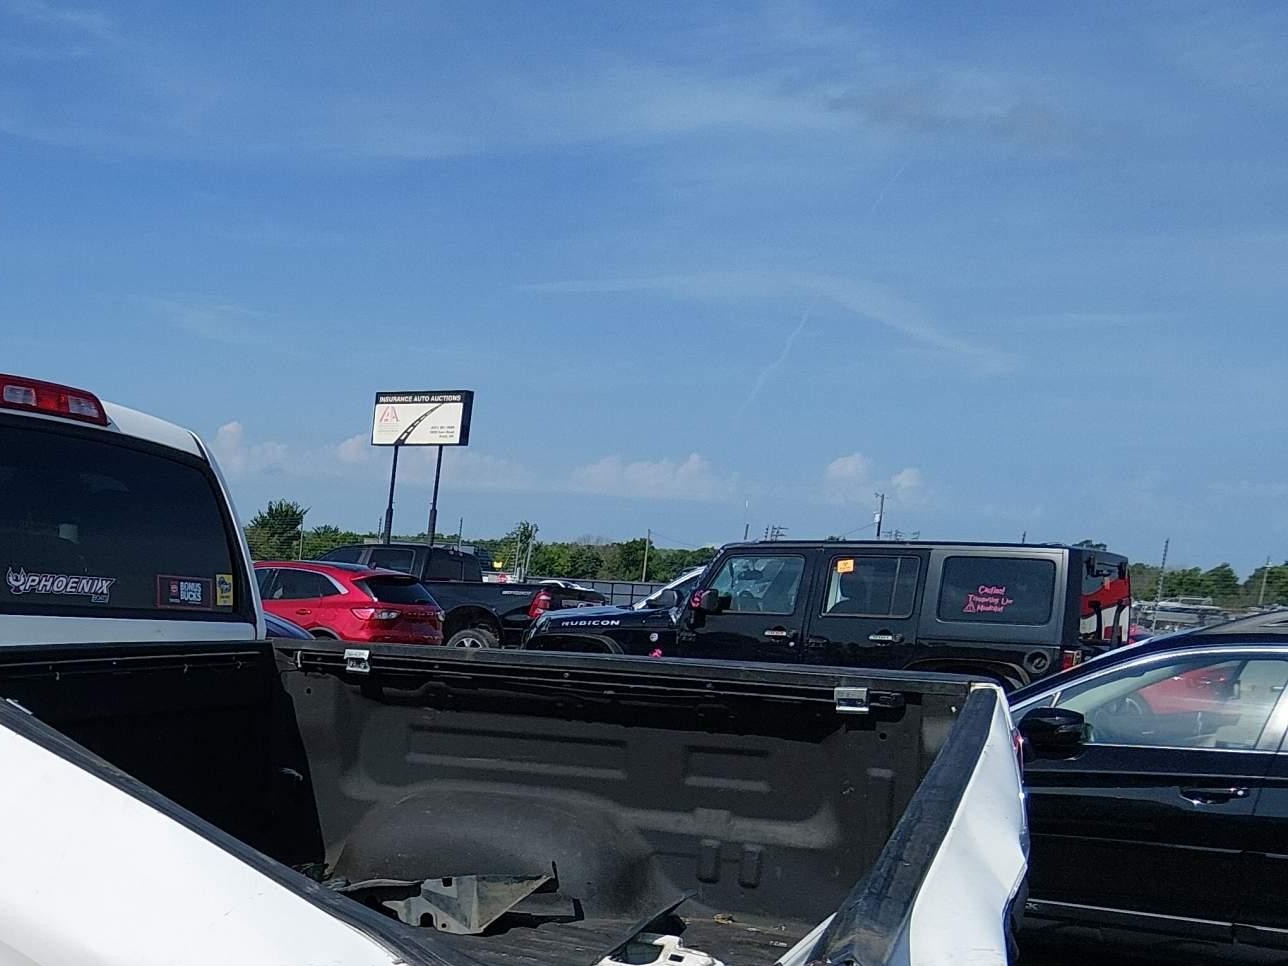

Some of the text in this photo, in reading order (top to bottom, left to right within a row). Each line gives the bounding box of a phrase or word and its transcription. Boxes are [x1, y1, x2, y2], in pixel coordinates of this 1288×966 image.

[379, 395, 412, 403] INSURANCE
[431, 394, 461, 402] AUCTIONS
[24, 574, 114, 595] PHOENIX
[179, 581, 201, 592] BONUS
[180, 591, 201, 601] BUCKS
[562, 619, 620, 627] RUBICON
